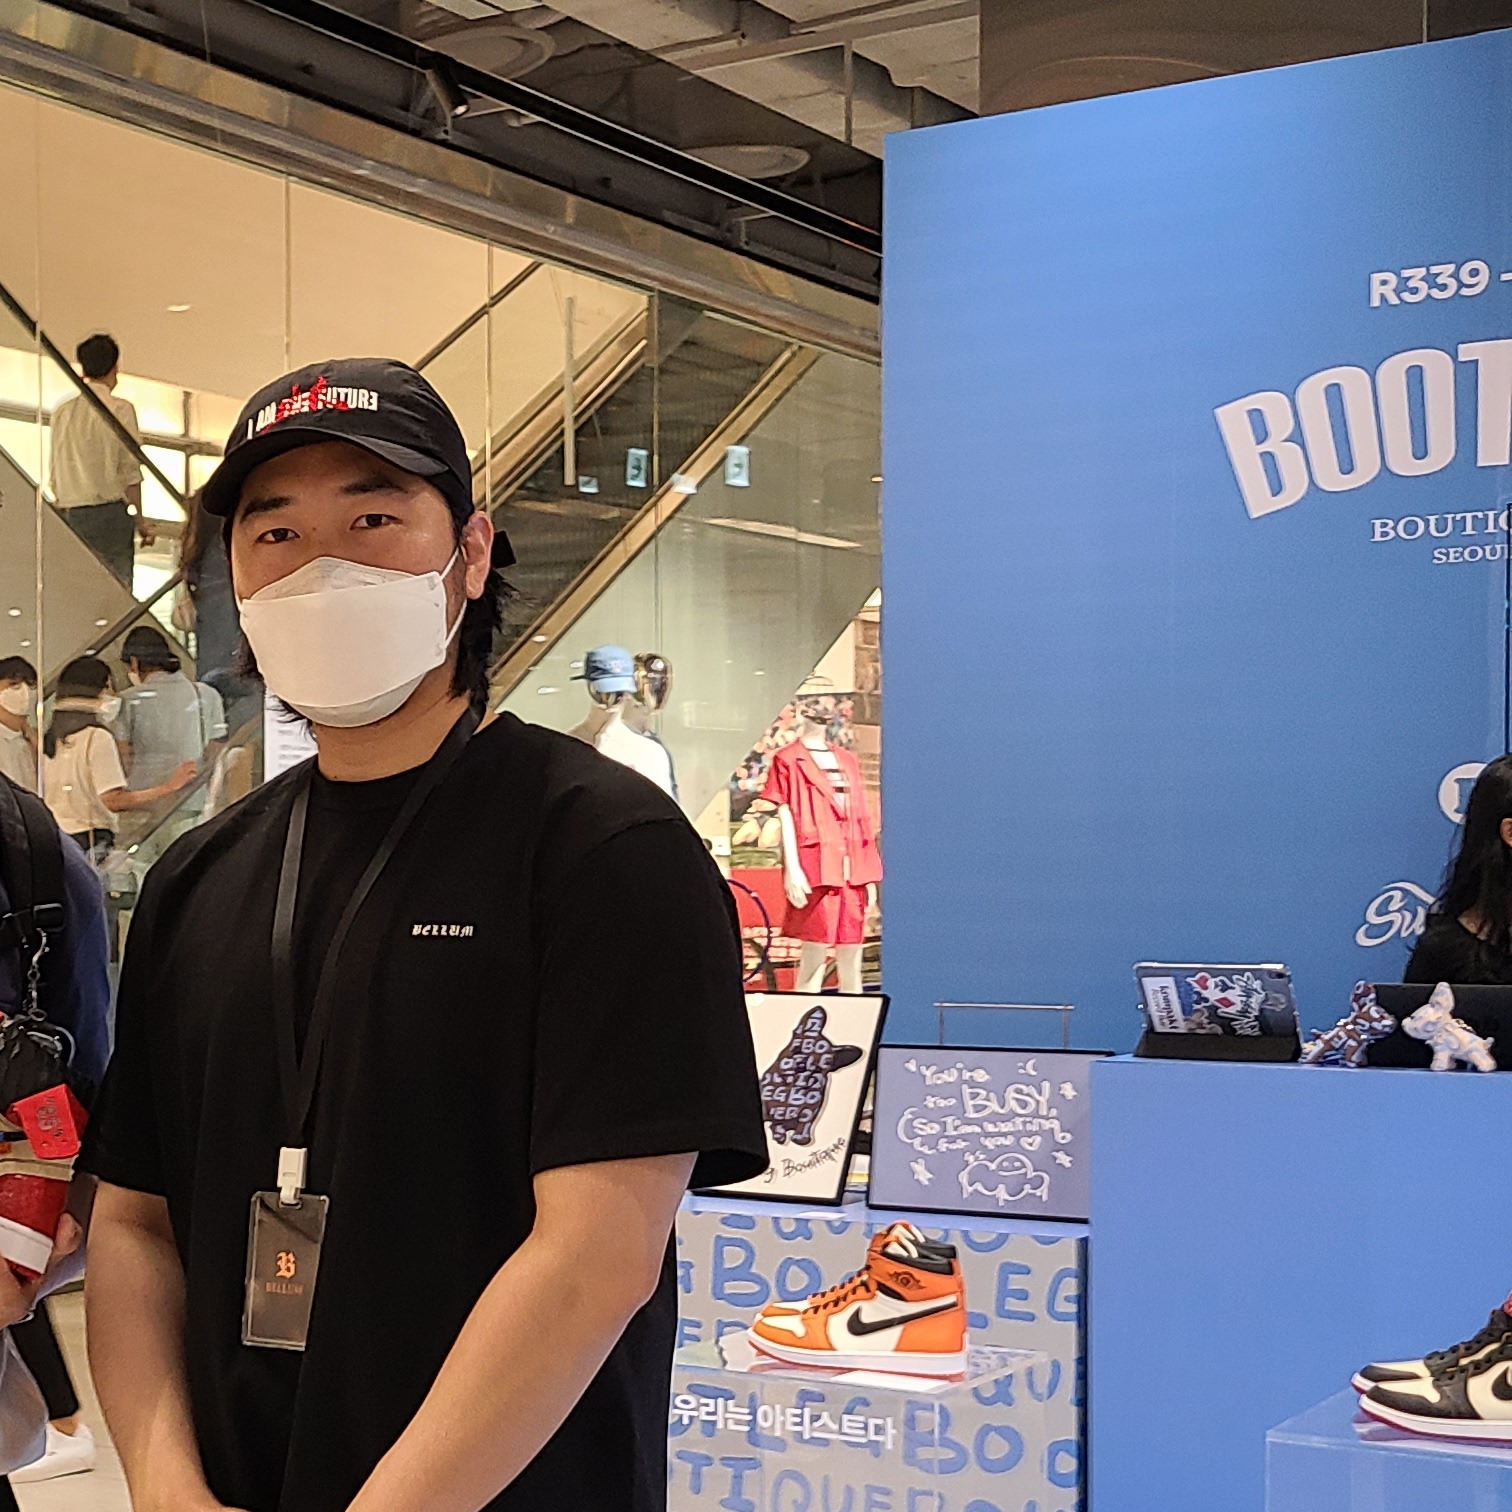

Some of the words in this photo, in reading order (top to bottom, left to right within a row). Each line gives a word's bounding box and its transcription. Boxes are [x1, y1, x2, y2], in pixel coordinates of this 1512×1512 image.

[1369, 260, 1489, 308] R339
[671, 1393, 753, 1433] 우리는
[756, 1404, 896, 1449] 아티스트다
